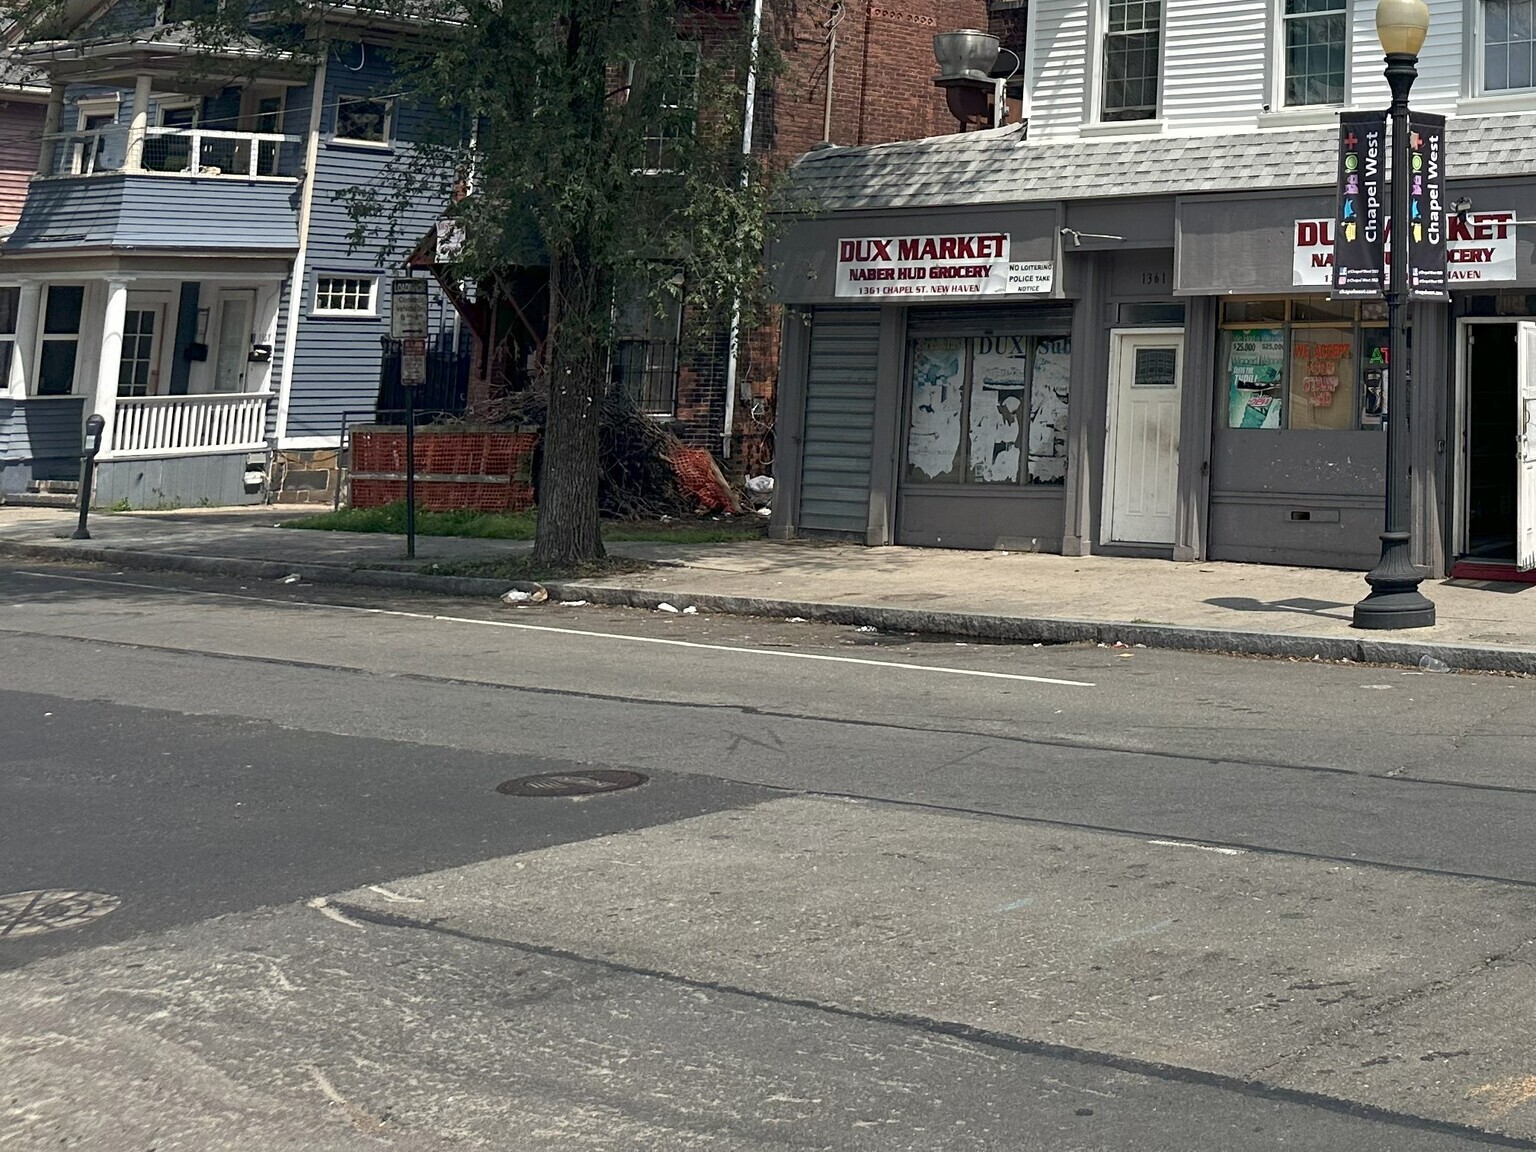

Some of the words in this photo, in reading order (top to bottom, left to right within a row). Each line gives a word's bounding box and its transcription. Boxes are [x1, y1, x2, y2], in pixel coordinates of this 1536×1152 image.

[1364, 131, 1379, 177] West
[1427, 135, 1439, 180] West
[1364, 180, 1381, 244] Chapel
[1427, 184, 1443, 245] Chapel
[1297, 221, 1335, 246] DU
[840, 239, 893, 262] DUX
[897, 235, 1008, 261] MARKET
[849, 267, 895, 281] NABER
[897, 266, 927, 280] HUD
[929, 265, 993, 280] GROCERY
[1020, 263, 1053, 271] LOITERING
[1035, 274, 1051, 282] TAKE
[1142, 272, 1166, 285] 1361
[858, 286, 880, 295] 1361
[882, 285, 913, 294] CHAPEL
[915, 285, 929, 294] ST.
[931, 285, 950, 293] NEW
[951, 284, 981, 293] HAVEN
[978, 336, 1024, 355] DUX
[1369, 347, 1389, 364] AT
